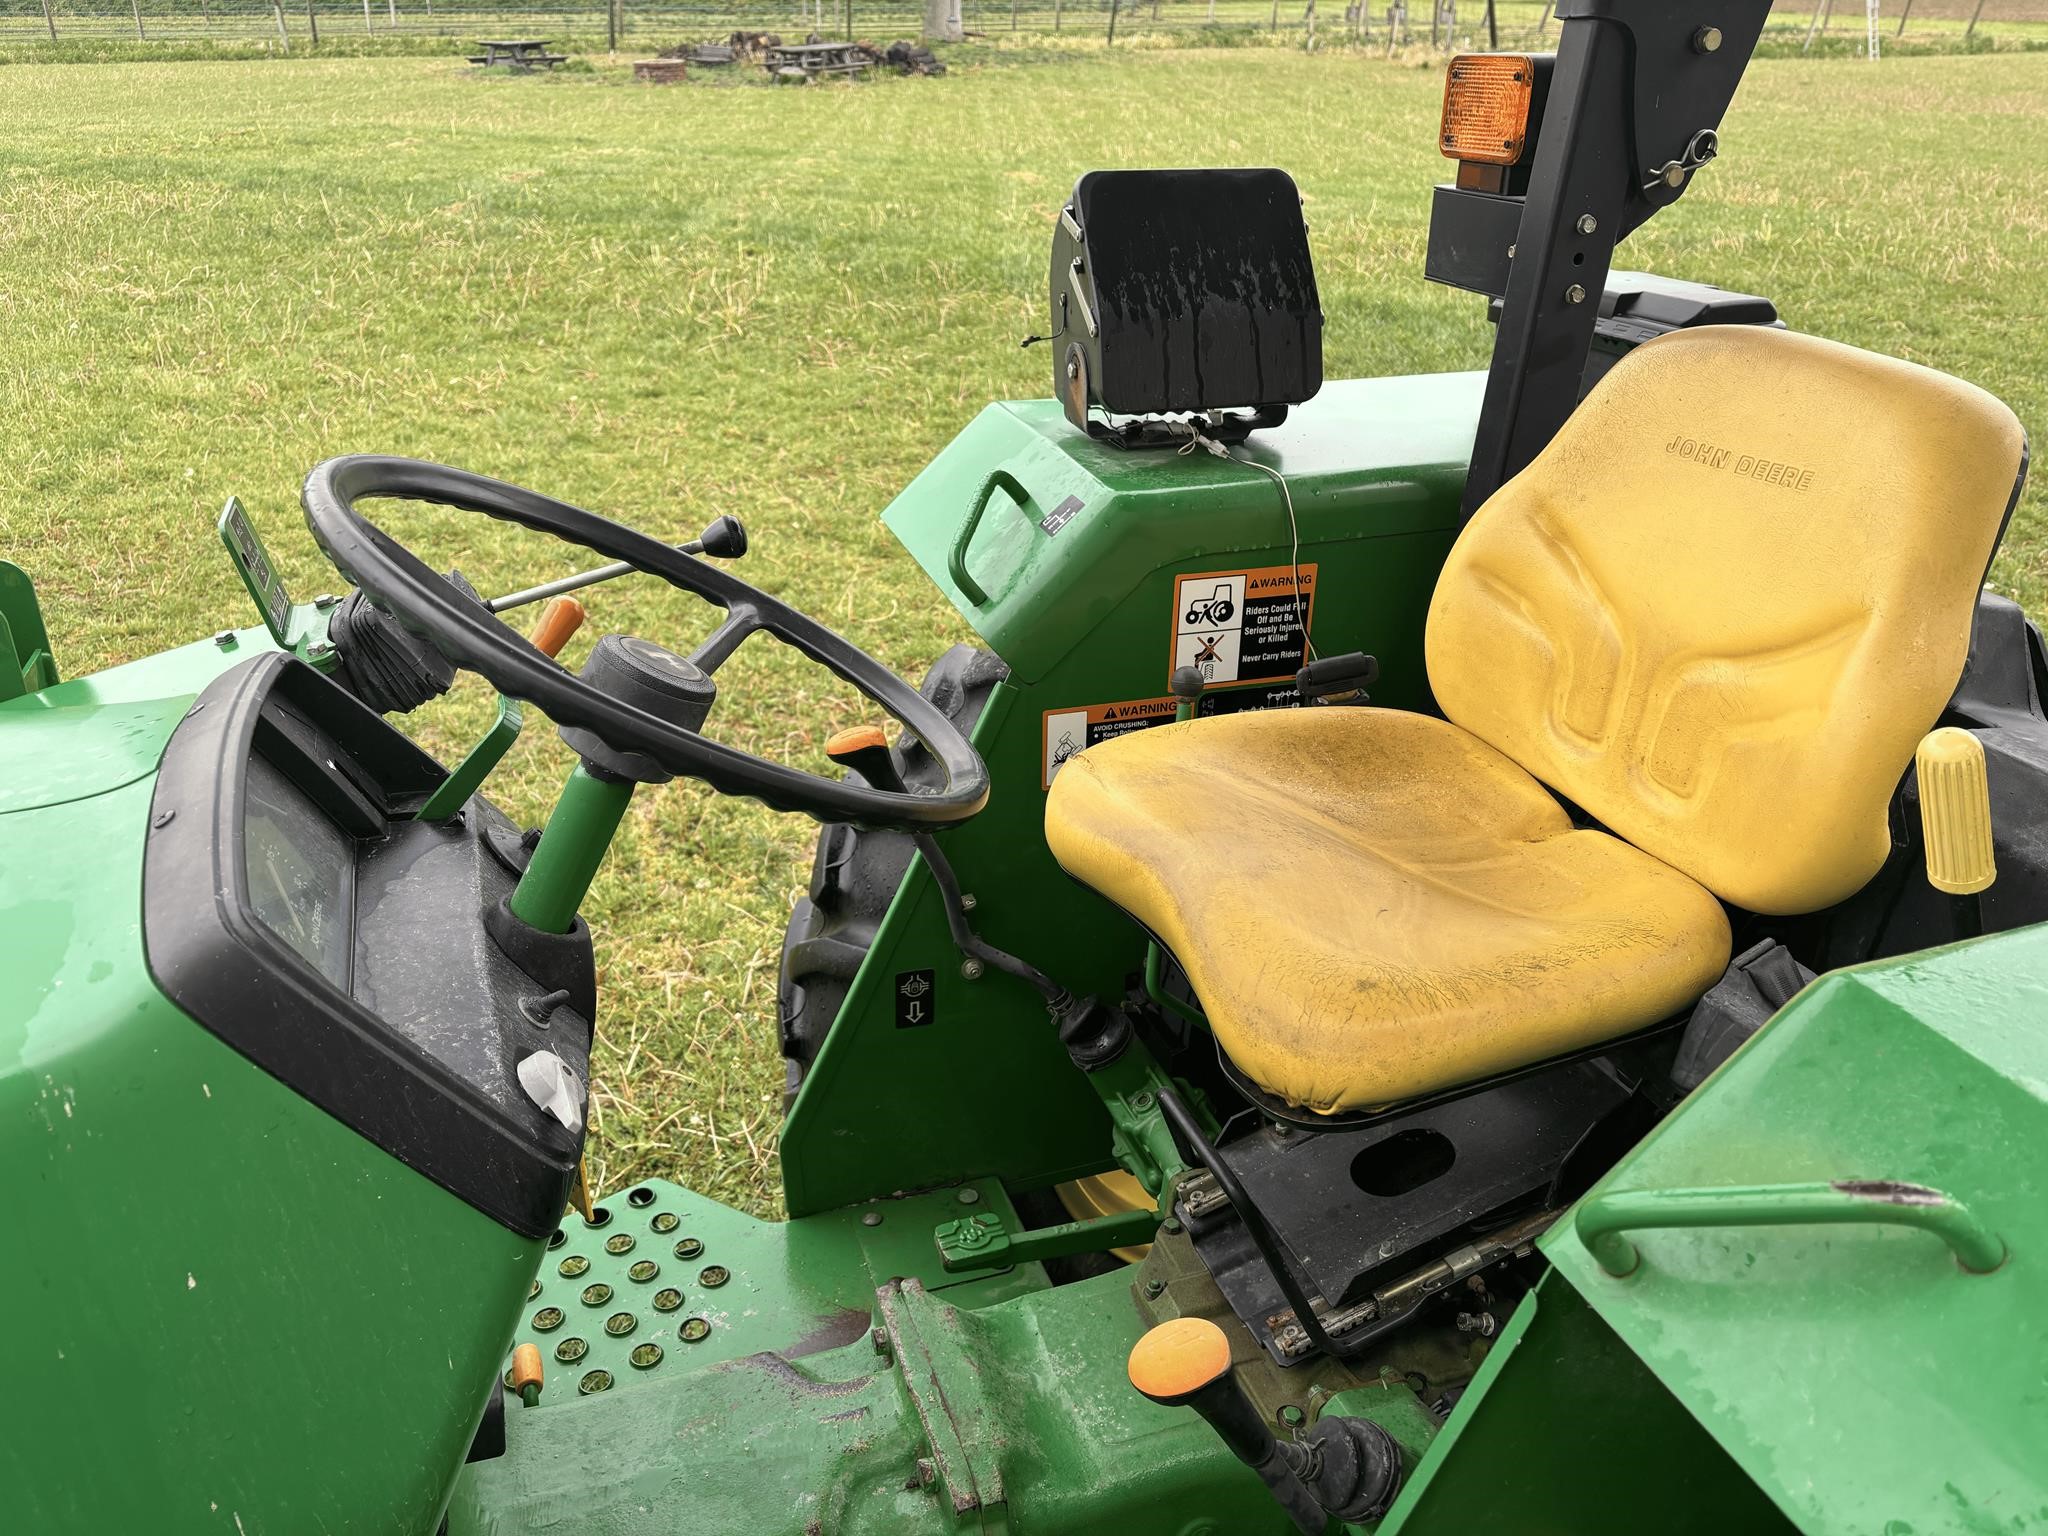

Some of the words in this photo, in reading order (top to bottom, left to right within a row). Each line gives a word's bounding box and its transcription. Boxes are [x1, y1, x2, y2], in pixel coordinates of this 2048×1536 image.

[1665, 435, 1732, 470] JOHN
[1734, 454, 1816, 492] DEERE
[1260, 575, 1312, 588] WARNNG
[1245, 607, 1269, 616] Riders
[1270, 603, 1291, 613] Could
[1292, 602, 1307, 611] Fll
[1257, 616, 1268, 624] Off
[1269, 614, 1283, 622] and
[1284, 613, 1294, 622] Be
[1244, 625, 1278, 636] Seriously
[1267, 633, 1289, 643] Killed
[1242, 655, 1261, 663] Never
[1262, 653, 1280, 661] Carry
[1280, 650, 1301, 659] Riders
[1119, 701, 1177, 717] WARNING
[1093, 724, 1113, 732] AVOID
[1114, 720, 1149, 730] CRUSHING:
